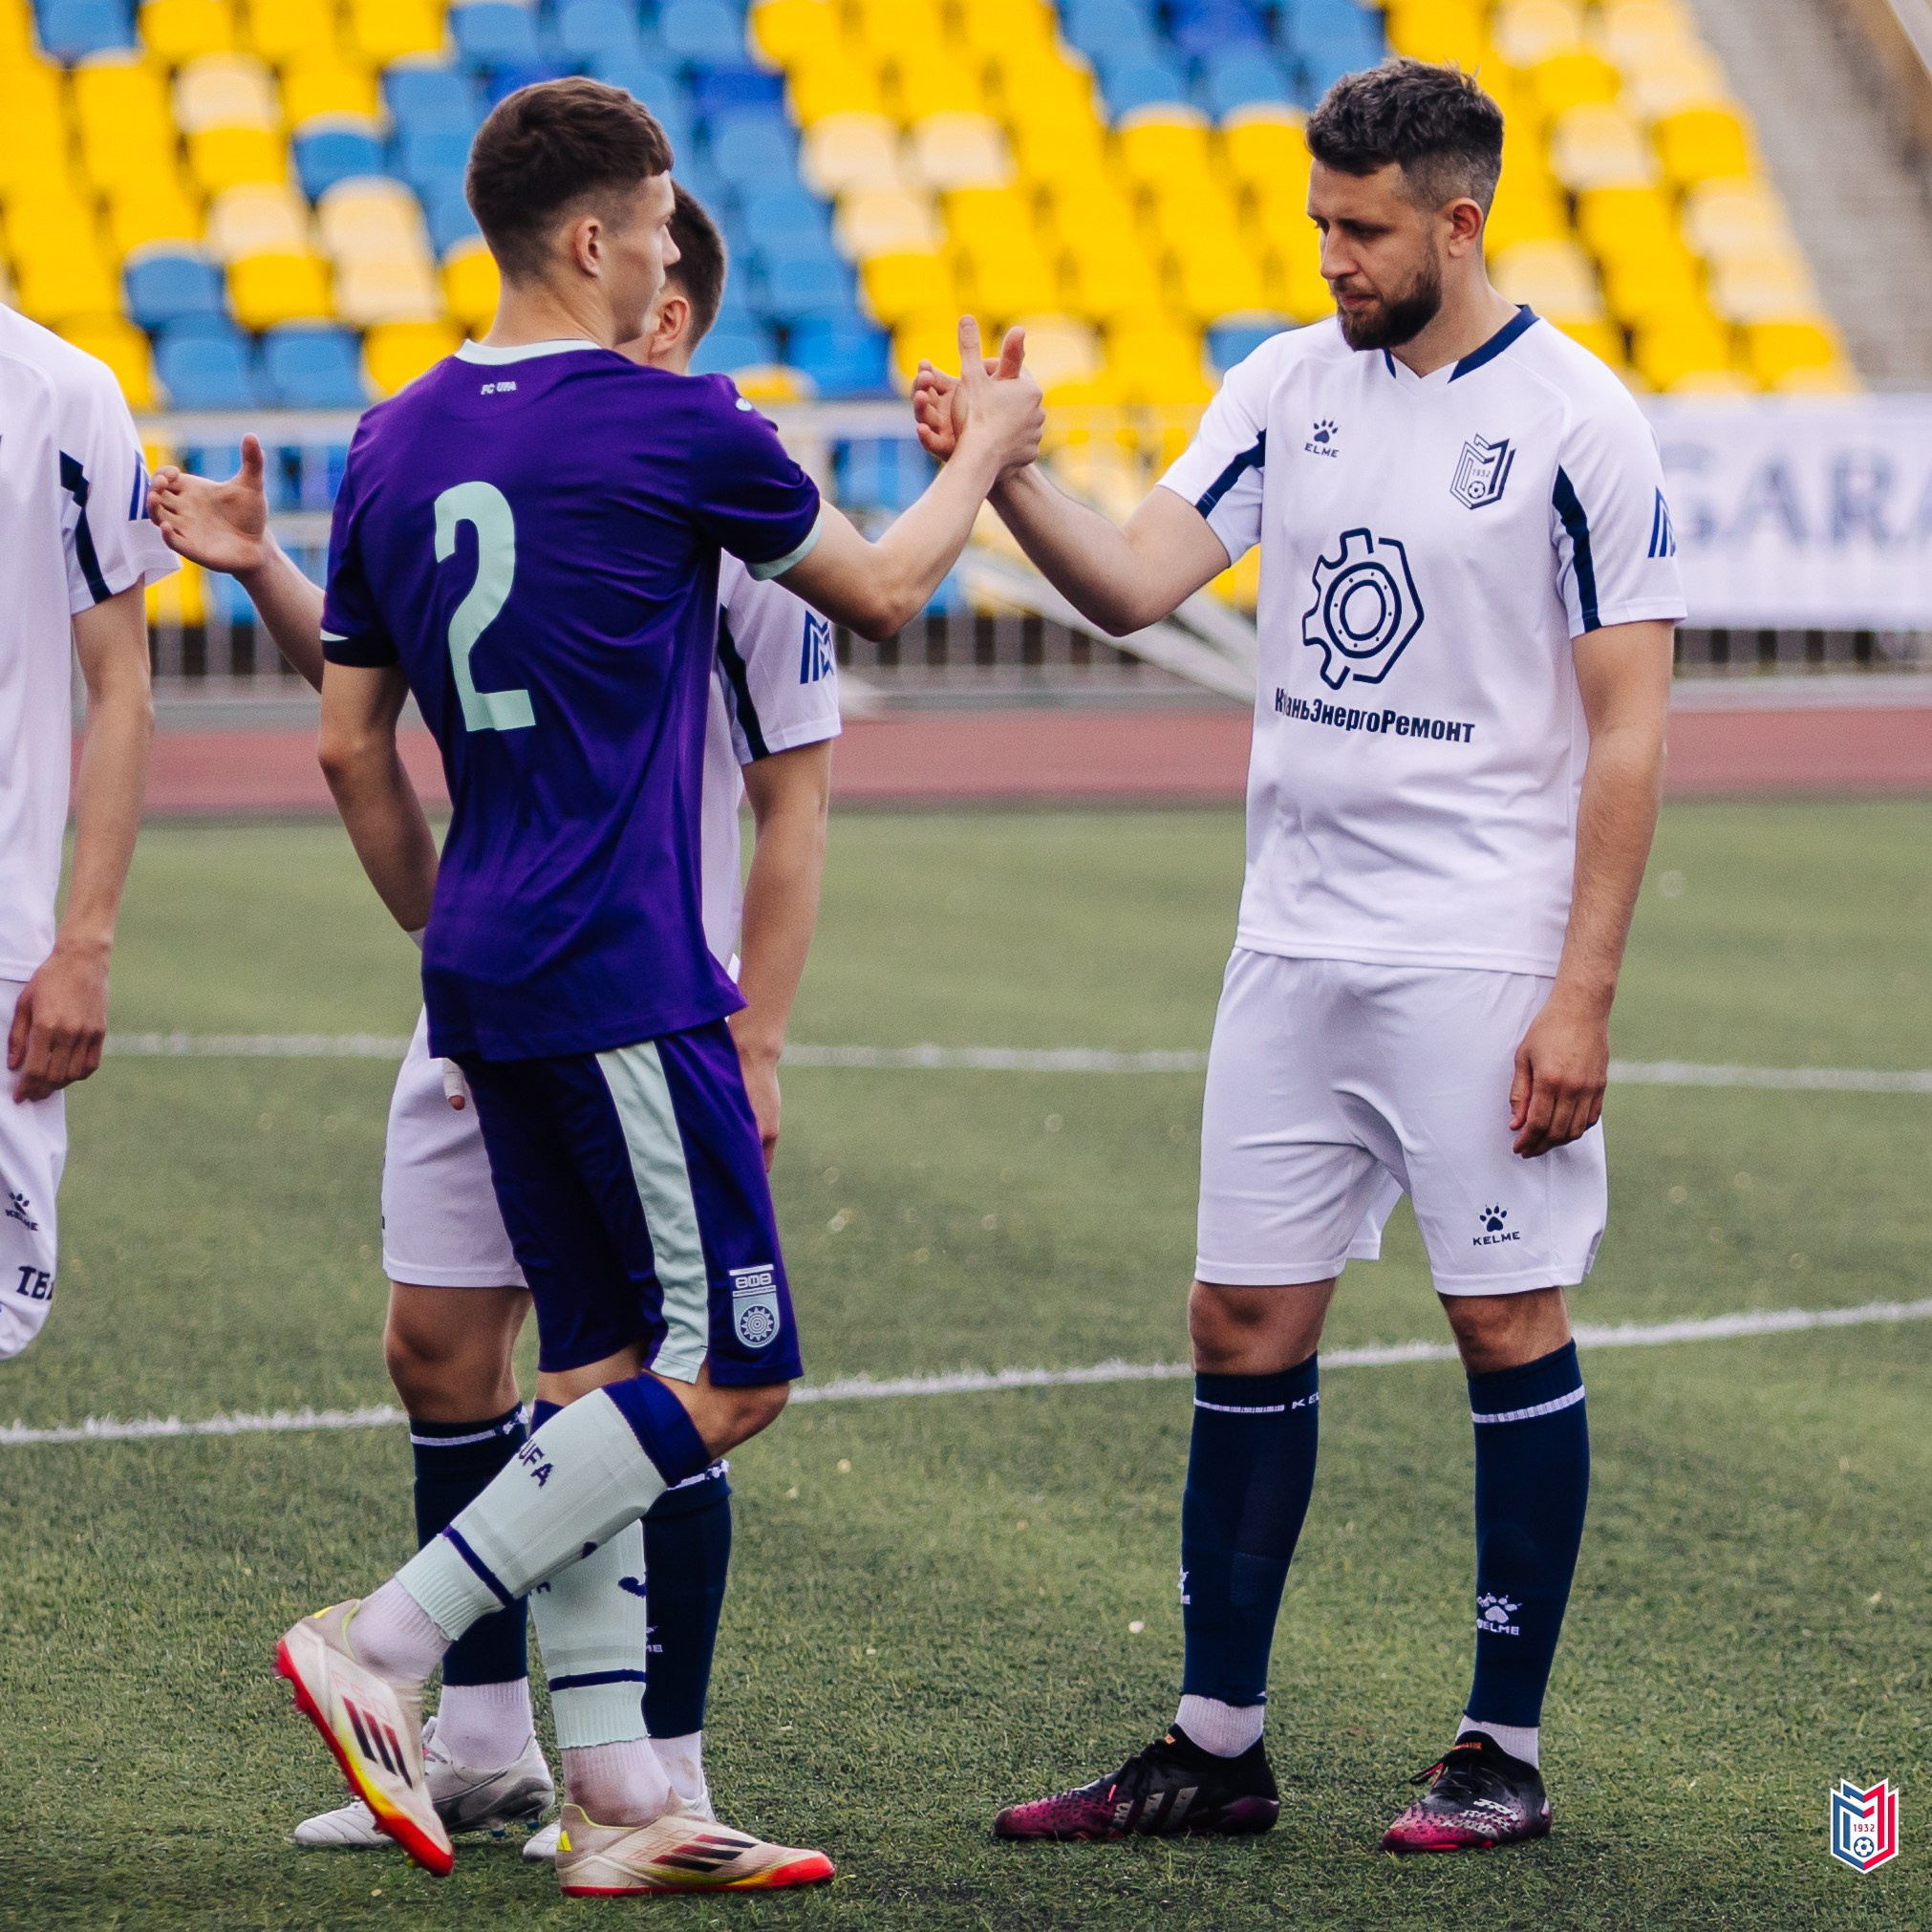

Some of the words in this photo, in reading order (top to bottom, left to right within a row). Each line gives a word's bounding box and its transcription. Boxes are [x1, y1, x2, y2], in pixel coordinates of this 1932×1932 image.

[1303, 442, 1340, 458] ELME
[1658, 441, 1932, 548] GAR
[434, 481, 536, 732] 2
[1275, 687, 1475, 743] КаньЭнергоРемонт
[1472, 1231, 1520, 1246] KELME
